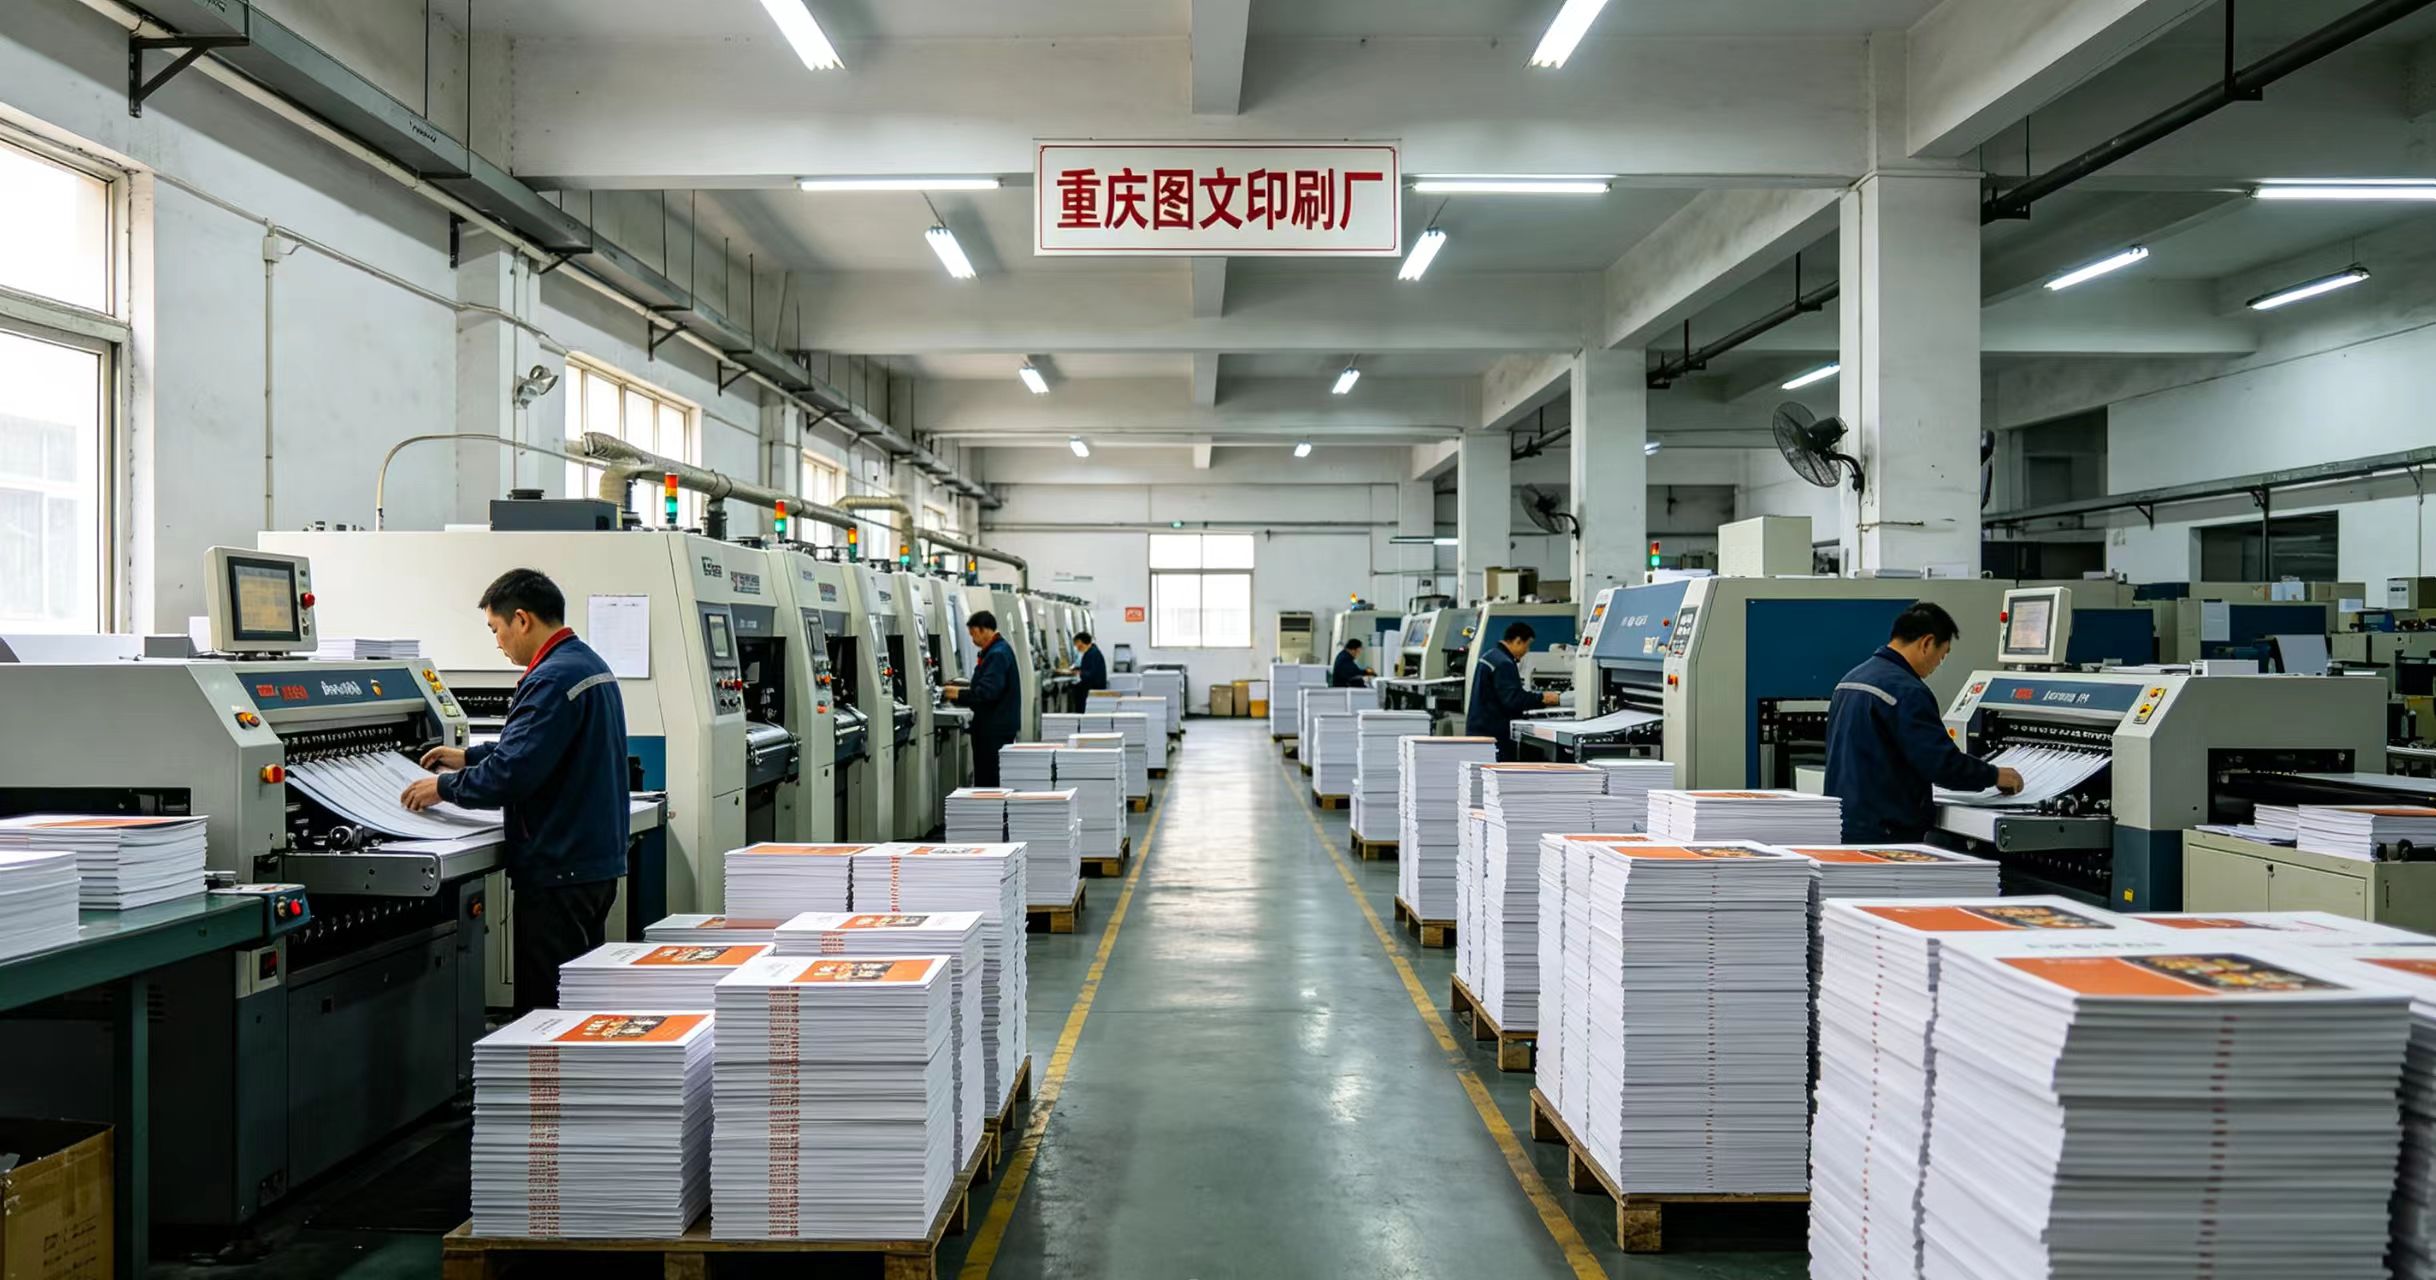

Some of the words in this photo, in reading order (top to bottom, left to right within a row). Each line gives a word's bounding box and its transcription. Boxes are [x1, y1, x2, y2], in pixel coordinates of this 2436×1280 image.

[1056, 167, 1383, 230] 重庆图文印刷厂
